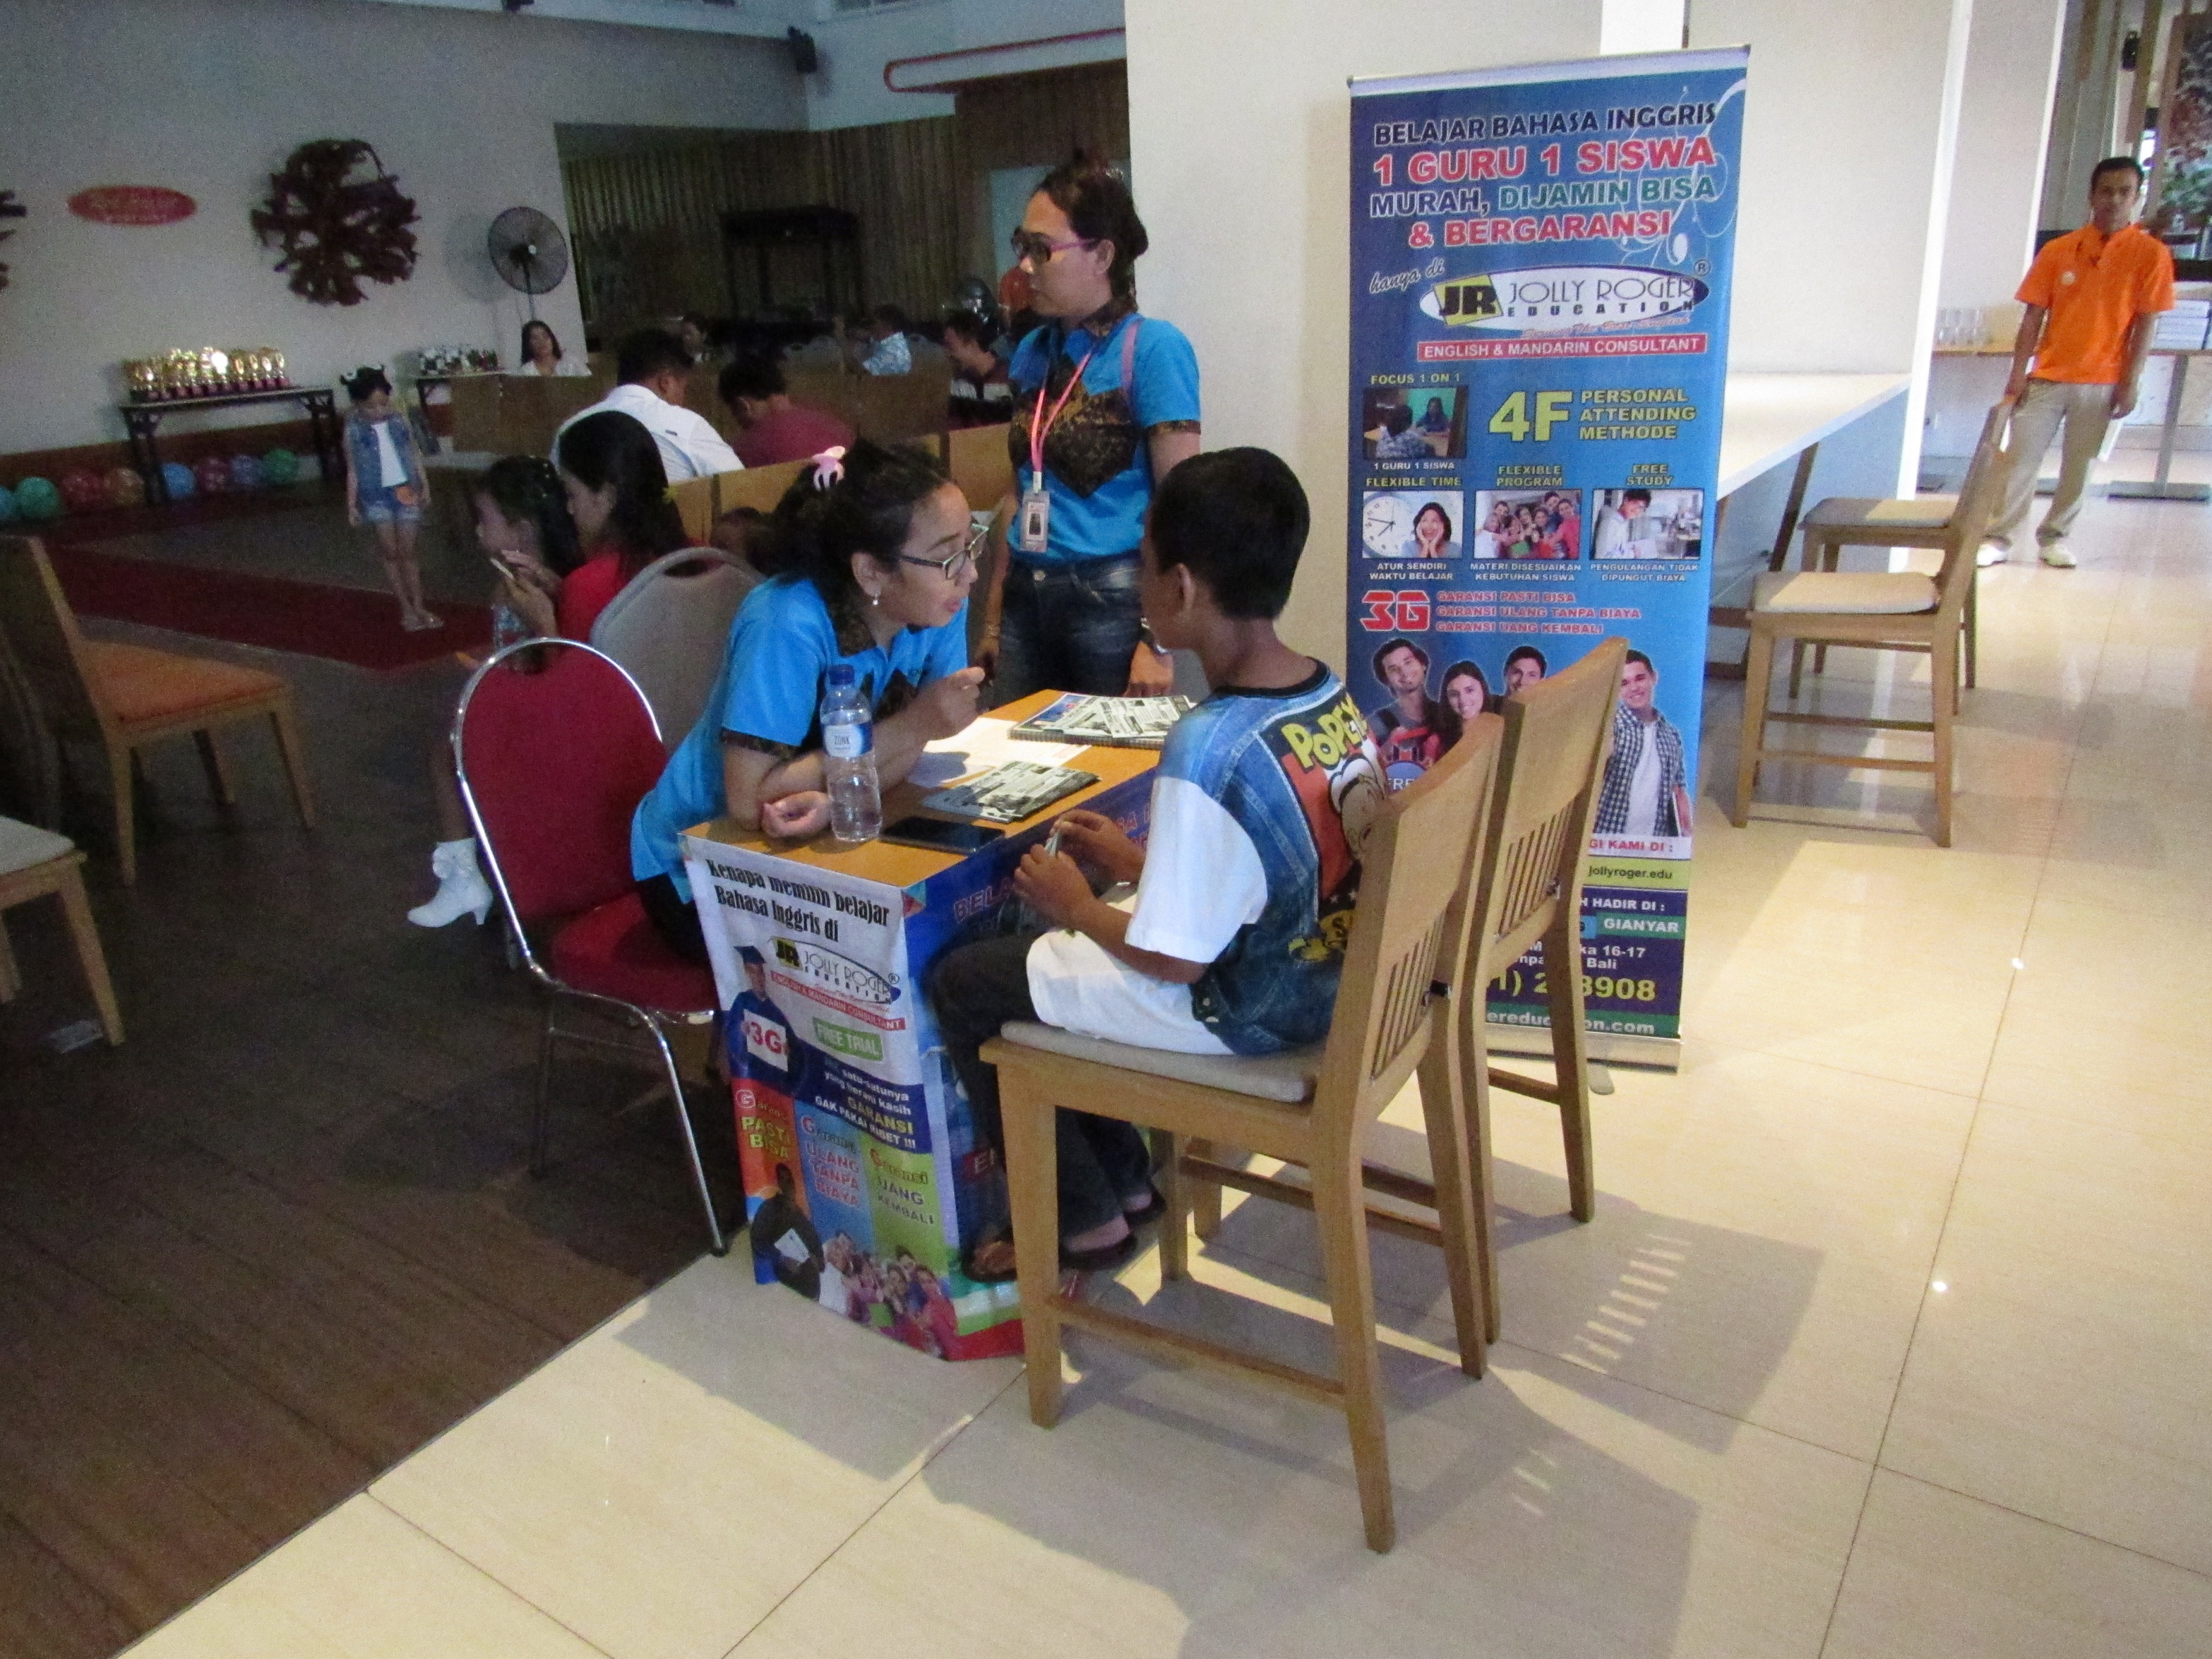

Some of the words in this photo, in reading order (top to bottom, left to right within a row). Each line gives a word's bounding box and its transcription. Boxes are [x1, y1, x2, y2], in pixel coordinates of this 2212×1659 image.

[1374, 118, 1485, 146] BELAJAR
[1492, 110, 1599, 138] BAHASA
[1607, 102, 1716, 129] INGGRIS
[1374, 153, 1392, 186] 1
[1408, 145, 1527, 182] GURU
[1541, 143, 1559, 175] 1
[1577, 136, 1715, 174] SISWA
[1370, 188, 1489, 218] MURAH,
[1498, 180, 1629, 212] DIJAMIN
[1640, 176, 1715, 203] BISA
[1408, 221, 1434, 249] &
[1445, 210, 1671, 246] BERGARANSI
[1369, 269, 1421, 294] hanya
[1425, 256, 1445, 278] di
[1440, 285, 1498, 316] JR
[1508, 279, 1589, 304] JOLLY
[1596, 276, 1695, 300] ROGER
[1507, 301, 1695, 317] EDUCATION
[1425, 343, 1489, 358] ENGLISH
[1492, 344, 1503, 356] &
[1508, 341, 1590, 355] MANDARIN
[1594, 338, 1699, 353] CONSULTANT
[1371, 373, 1415, 385] FOCUS
[1419, 373, 1427, 383] 1
[1430, 373, 1449, 383] ON
[1454, 371, 1460, 383] 1
[1580, 388, 1689, 404] PERSONAL
[1488, 389, 1574, 443] 4F
[1580, 406, 1697, 422] ATTENDING
[1578, 424, 1677, 441] METHODE
[1423, 461, 1455, 470] SISWA
[1497, 465, 1562, 477] FLEXIBLE
[1632, 464, 1668, 476] FREE
[1366, 477, 1427, 487] FLEXIBLE
[1431, 476, 1462, 487] TIME
[1496, 476, 1563, 487] PROGRAM
[1626, 475, 1673, 487] STUDY
[1470, 563, 1508, 571] MATERI
[1511, 563, 1581, 572] DISESUAIKAN
[1590, 563, 1667, 572] PENGULANGAN
[1370, 572, 1406, 581] WAKTU
[1475, 572, 1541, 581] KEBUTUHAN
[1542, 573, 1575, 581] SISWA
[1602, 574, 1655, 582] DIPUNGUT
[1656, 574, 1686, 582] BIAYA
[1436, 591, 1498, 604] GARANSI
[1500, 591, 1539, 603] PASTI
[1543, 592, 1576, 604] BISA
[1361, 589, 1430, 632] 3G
[1436, 605, 1497, 618] GARANSI
[1500, 607, 1547, 618] ULANG
[1552, 607, 1595, 619] TANPA
[1599, 608, 1641, 619] BIAYA
[1436, 621, 1496, 634] GARANSI
[1500, 622, 1539, 634] UANG
[1541, 623, 1604, 634] KEMBALI
[1608, 840, 1644, 851] KAMI
[1650, 842, 1664, 851] DI
[706, 859, 766, 889] Kenapa
[833, 891, 890, 926] belajar
[1592, 898, 1638, 910] HADIR
[1641, 901, 1656, 911] DI
[714, 885, 769, 917] Bahasa
[772, 900, 821, 935] Inggris
[824, 918, 839, 942] di
[1604, 918, 1679, 933] GIANYAR
[1602, 945, 1646, 958] 16-17
[804, 950, 839, 976] JOLLY
[1587, 957, 1617, 970] Bali
[808, 989, 847, 1012] MANDARIN
[750, 1021, 782, 1055] 3G
[815, 1096, 838, 1112] GAK
[878, 1098, 911, 1115] kasih
[848, 1096, 914, 1134] GARANSI
